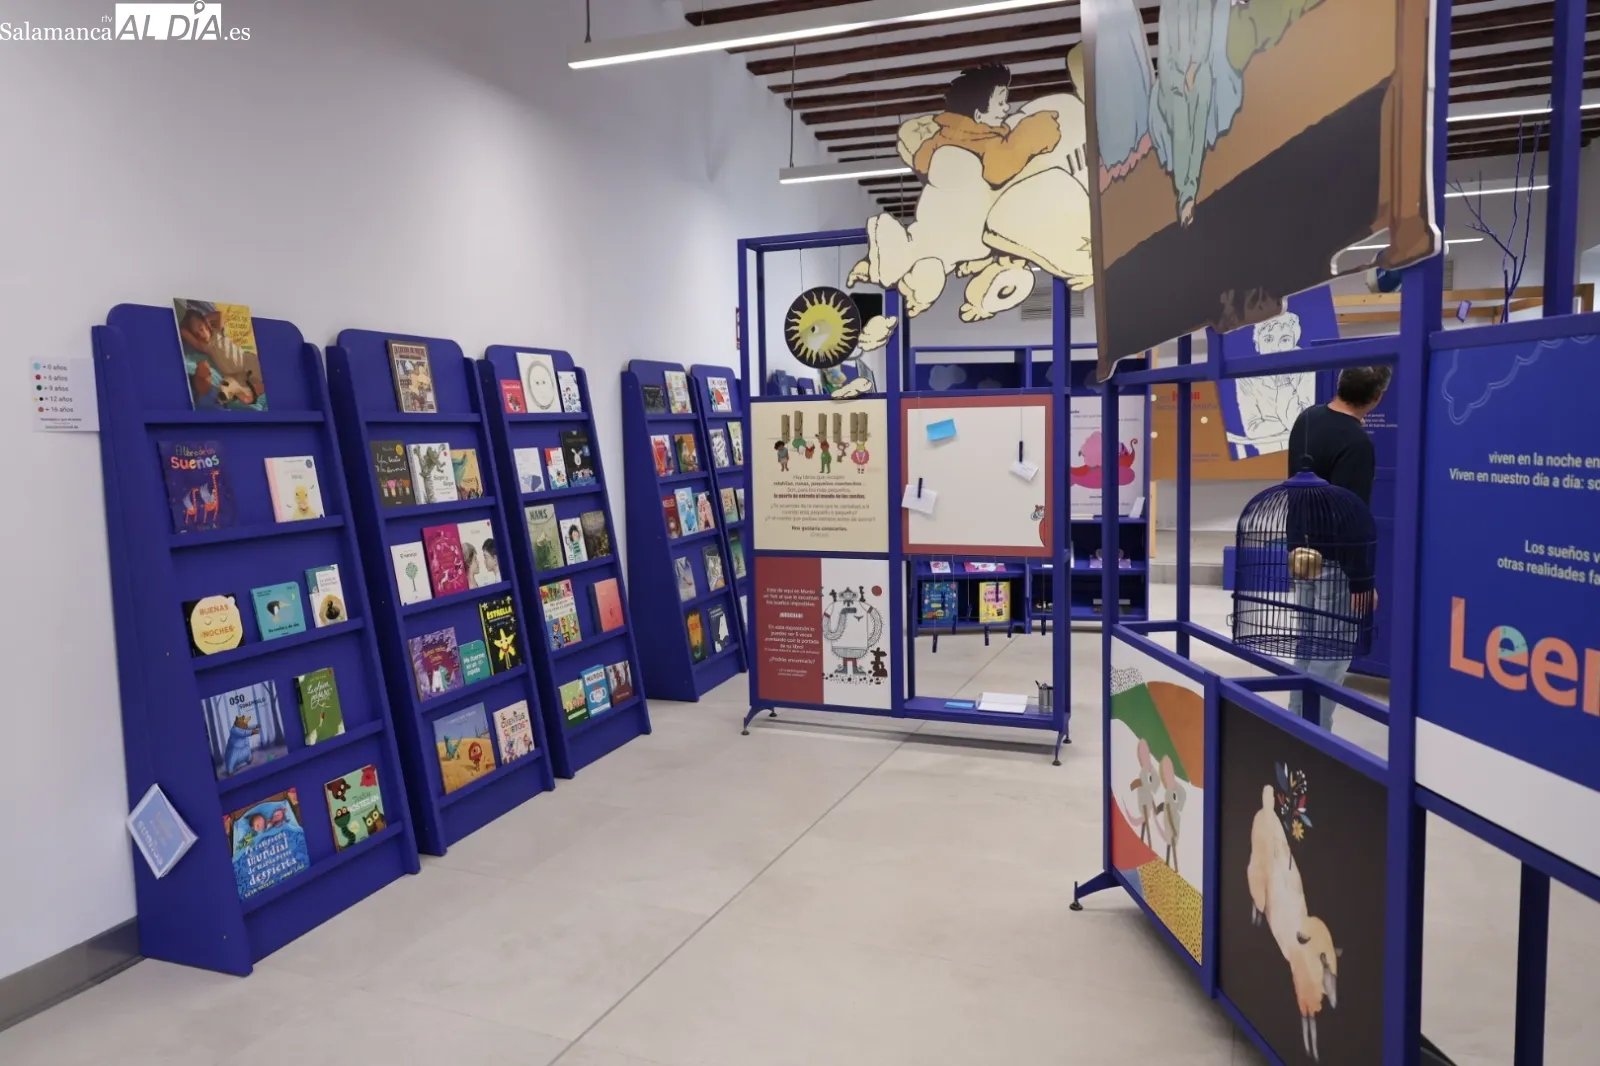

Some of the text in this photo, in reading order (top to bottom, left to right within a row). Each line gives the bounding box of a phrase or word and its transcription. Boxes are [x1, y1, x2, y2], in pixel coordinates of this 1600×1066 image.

[1489, 452, 1516, 465] viven
[1518, 455, 1531, 466] en
[1534, 452, 1544, 467] la
[1546, 453, 1582, 468] noche
[1449, 468, 1475, 481] Viven
[1476, 471, 1489, 483] en
[1491, 471, 1530, 486] nuestro
[1532, 472, 1550, 487] día
[1552, 476, 1560, 488] a
[529, 508, 548, 520] HANS
[1524, 540, 1545, 556] Los
[1547, 544, 1590, 562] sueños
[1497, 556, 1524, 572] otras
[1526, 560, 1586, 583] realidades
[199, 603, 229, 615] BUENAS
[202, 625, 234, 638] NOCHES
[229, 694, 245, 706] OSO
